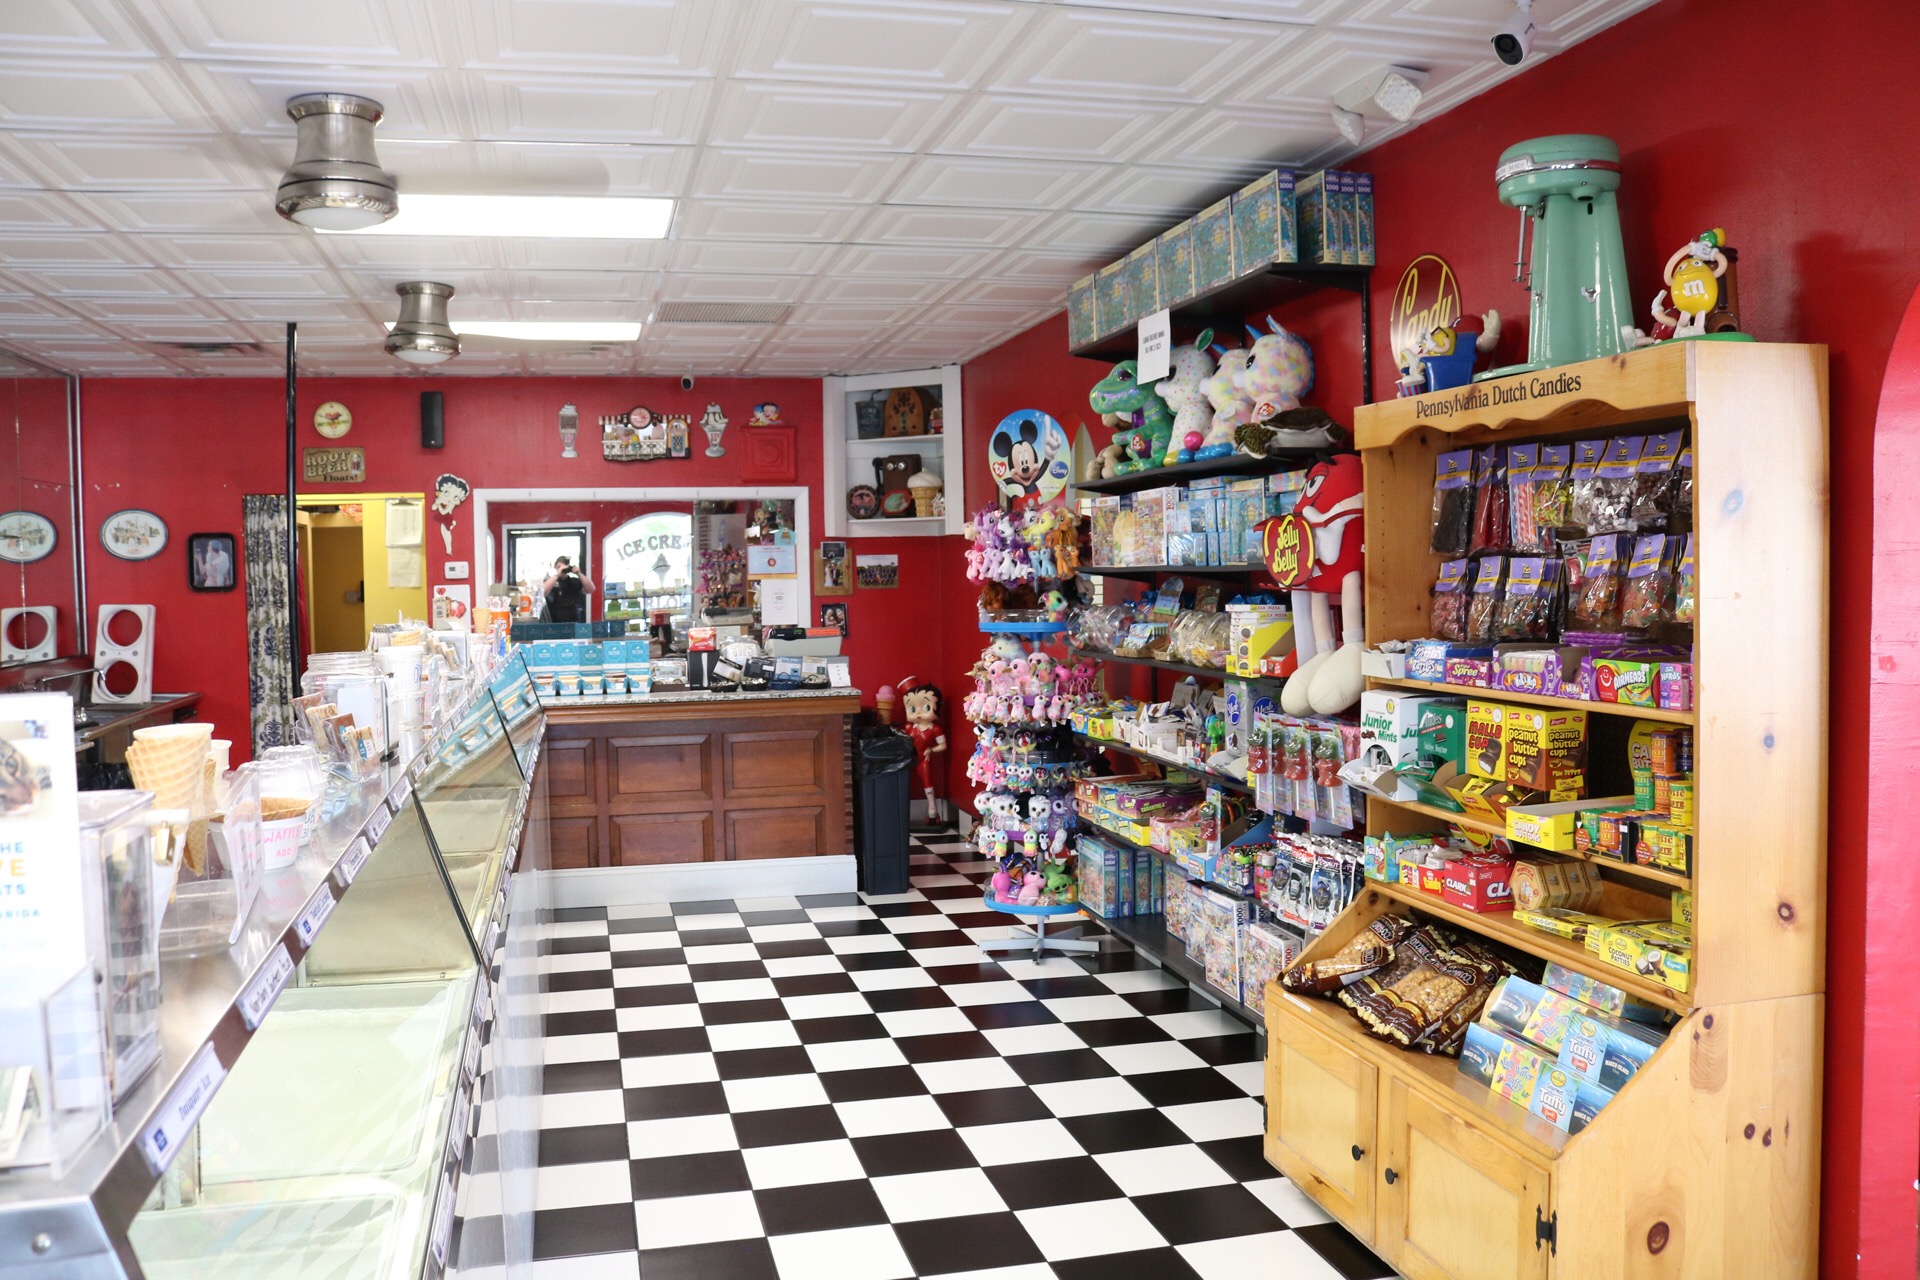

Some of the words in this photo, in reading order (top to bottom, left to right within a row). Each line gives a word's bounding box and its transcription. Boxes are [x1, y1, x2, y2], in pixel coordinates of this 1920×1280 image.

[1341, 185, 1354, 193] 1000
[1416, 391, 1489, 419] Pennsylvania
[1493, 382, 1527, 405] Dutch
[1530, 374, 1582, 399] Candies
[306, 450, 350, 466] ROOT
[307, 461, 349, 477] BEER
[1166, 492, 1175, 511] 1000
[1277, 524, 1300, 552] Jelly
[616, 539, 645, 560] ICE
[648, 534, 692, 550] CRE
[1272, 549, 1298, 574] Belly
[1452, 665, 1478, 677] Spree
[1614, 670, 1647, 690] AIRHEADS
[1362, 713, 1392, 730] Junior
[1419, 710, 1442, 728] Andes
[1378, 732, 1397, 743] Mints
[1401, 728, 1418, 739] Ju
[1469, 721, 1502, 739] MALLO
[1509, 728, 1539, 744] peanut
[1550, 730, 1580, 741] peanut
[1469, 735, 1490, 749] CUP
[1513, 741, 1539, 756] butter
[1553, 739, 1580, 748] butter
[1509, 753, 1527, 767] cups
[1550, 748, 1568, 757] cups
[264, 824, 303, 843] WAFFLE
[1512, 820, 1541, 834] CANDY
[1514, 830, 1542, 843] BUTTONS
[0, 842, 24, 854] HE
[1423, 876, 1442, 894] Candy
[1446, 878, 1467, 893] CLARK
[1608, 946, 1633, 960] COCONUT
[1611, 954, 1630, 967] PATTIES
[1538, 1006, 1554, 1017] Salt
[1542, 1022, 1560, 1038] Taffy
[1569, 1037, 1597, 1065] Taffy
[1501, 1056, 1515, 1070] Salt
[1515, 1066, 1534, 1081] Water
[1507, 1074, 1523, 1091] Taffy
[1539, 1086, 1567, 1116] Taffy
